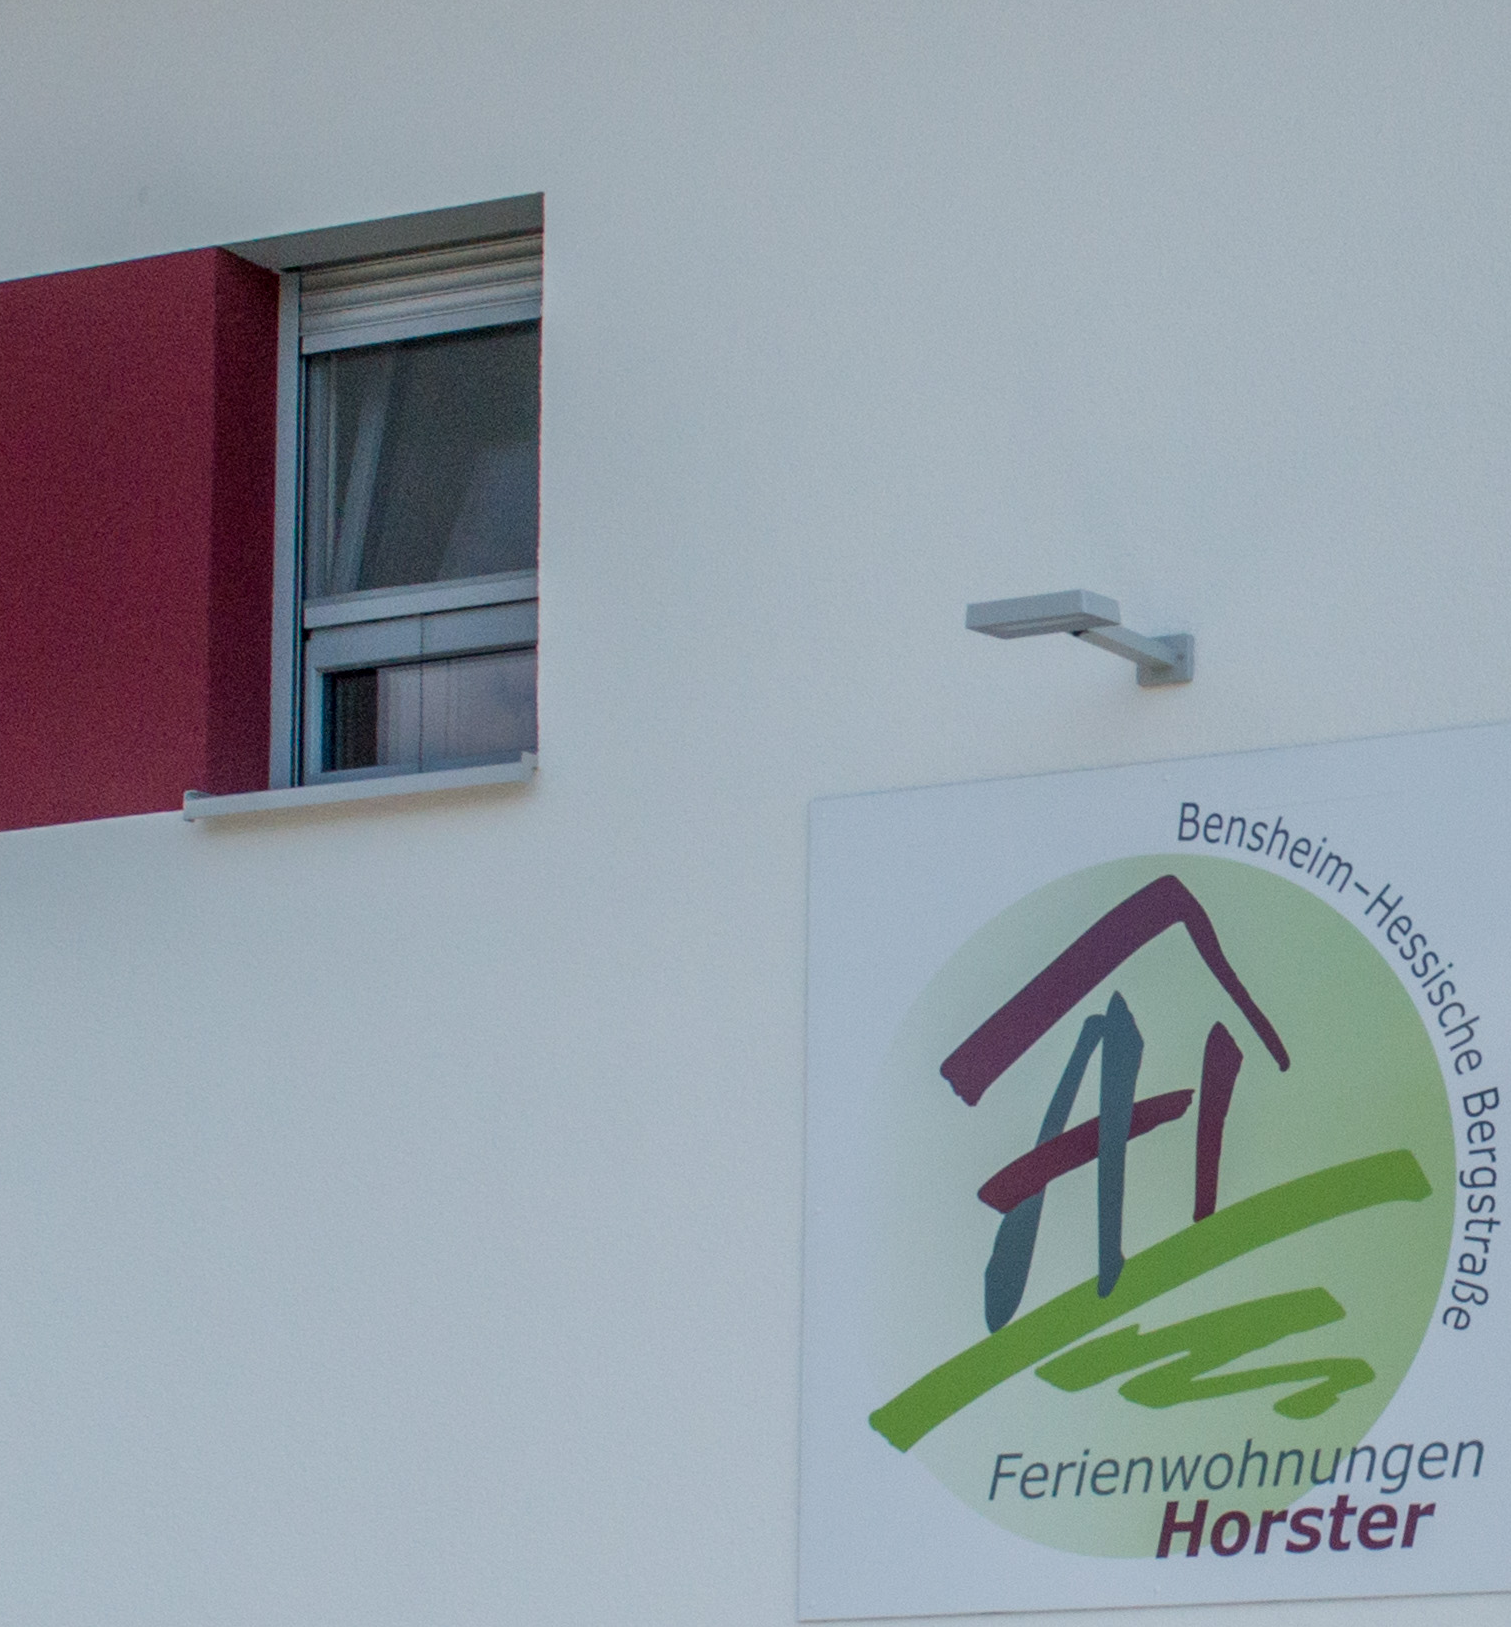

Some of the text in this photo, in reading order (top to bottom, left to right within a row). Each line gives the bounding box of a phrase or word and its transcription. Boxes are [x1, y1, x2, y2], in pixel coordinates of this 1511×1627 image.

[1177, 801, 1502, 1334] Bensheim-Hessische Bergstraße
[987, 1437, 1487, 1502] Ferienwohnungen
[1154, 1493, 1437, 1560] Horster
